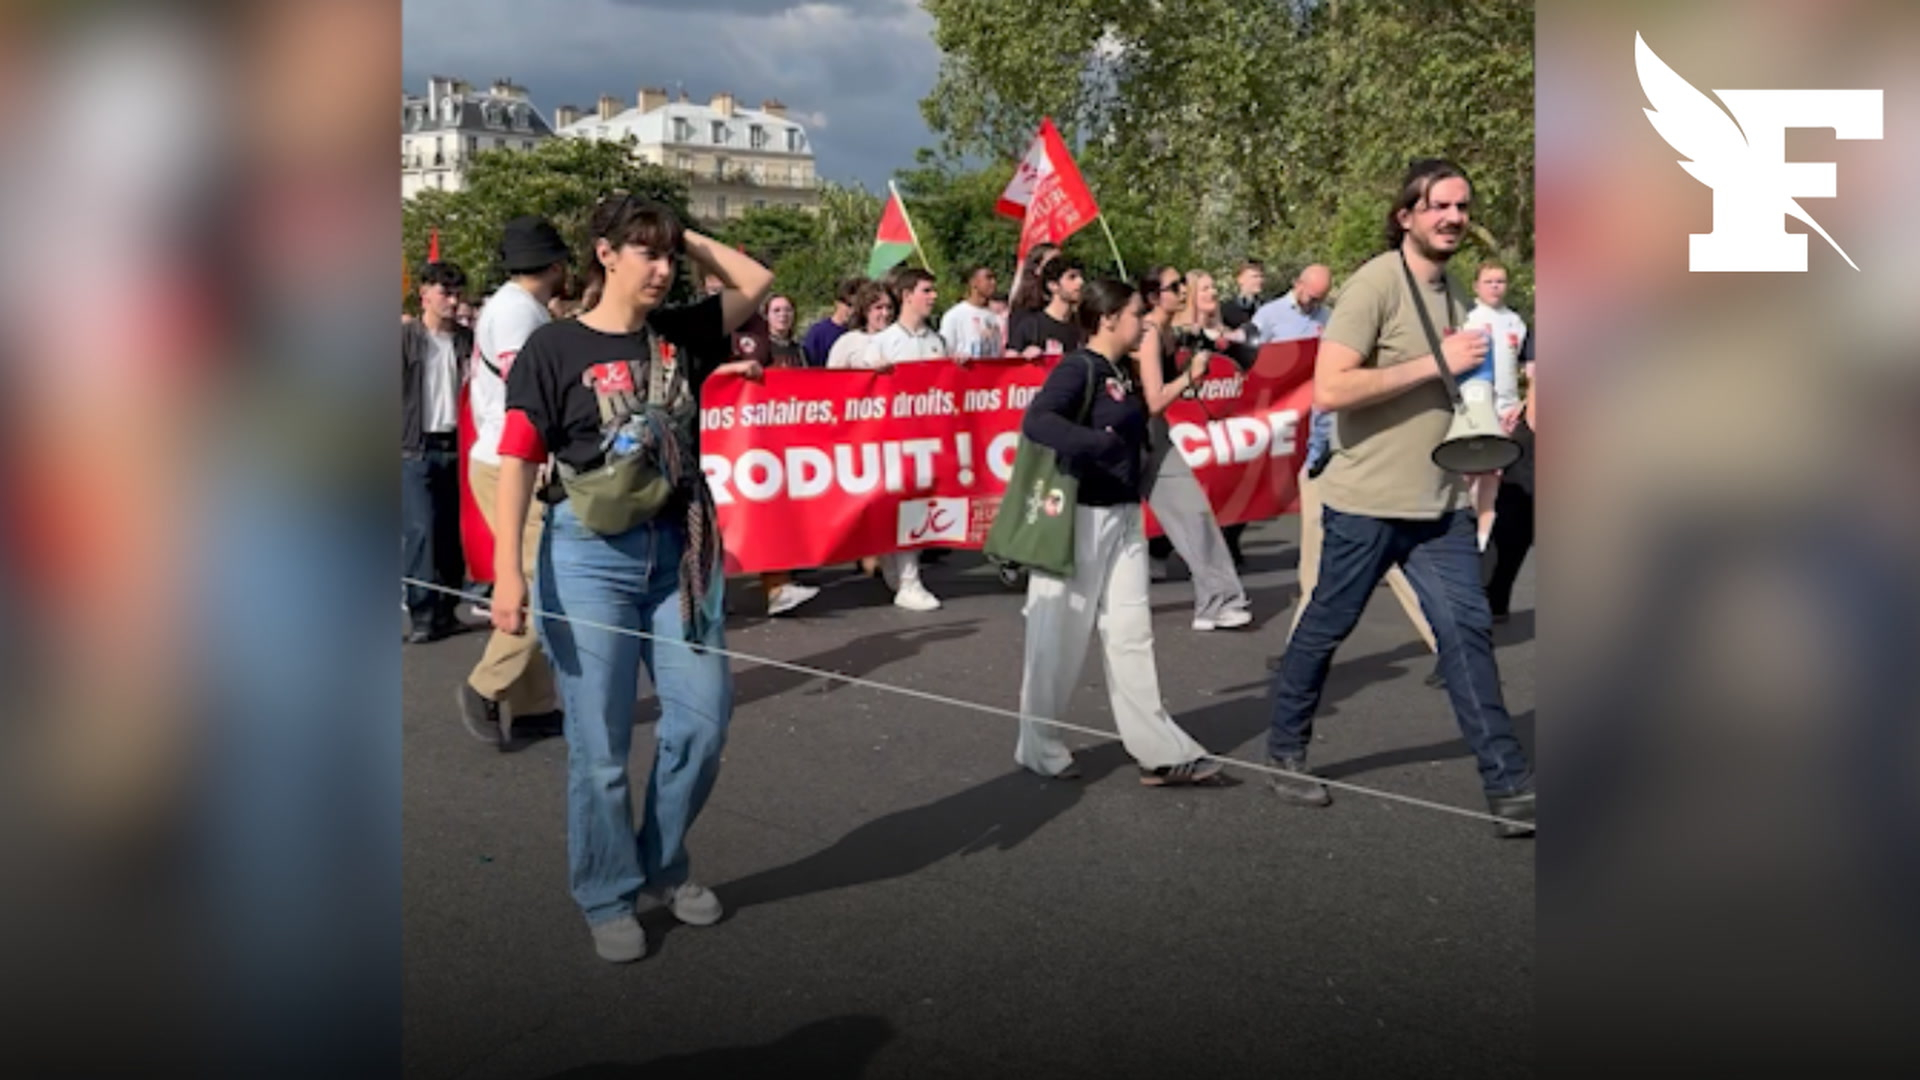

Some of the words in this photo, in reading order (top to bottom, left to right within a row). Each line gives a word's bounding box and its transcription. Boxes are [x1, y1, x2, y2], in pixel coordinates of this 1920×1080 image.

[741, 396, 838, 428] salaires,
[844, 396, 887, 421] nos
[892, 387, 960, 416] droits,
[963, 387, 1002, 412] nos
